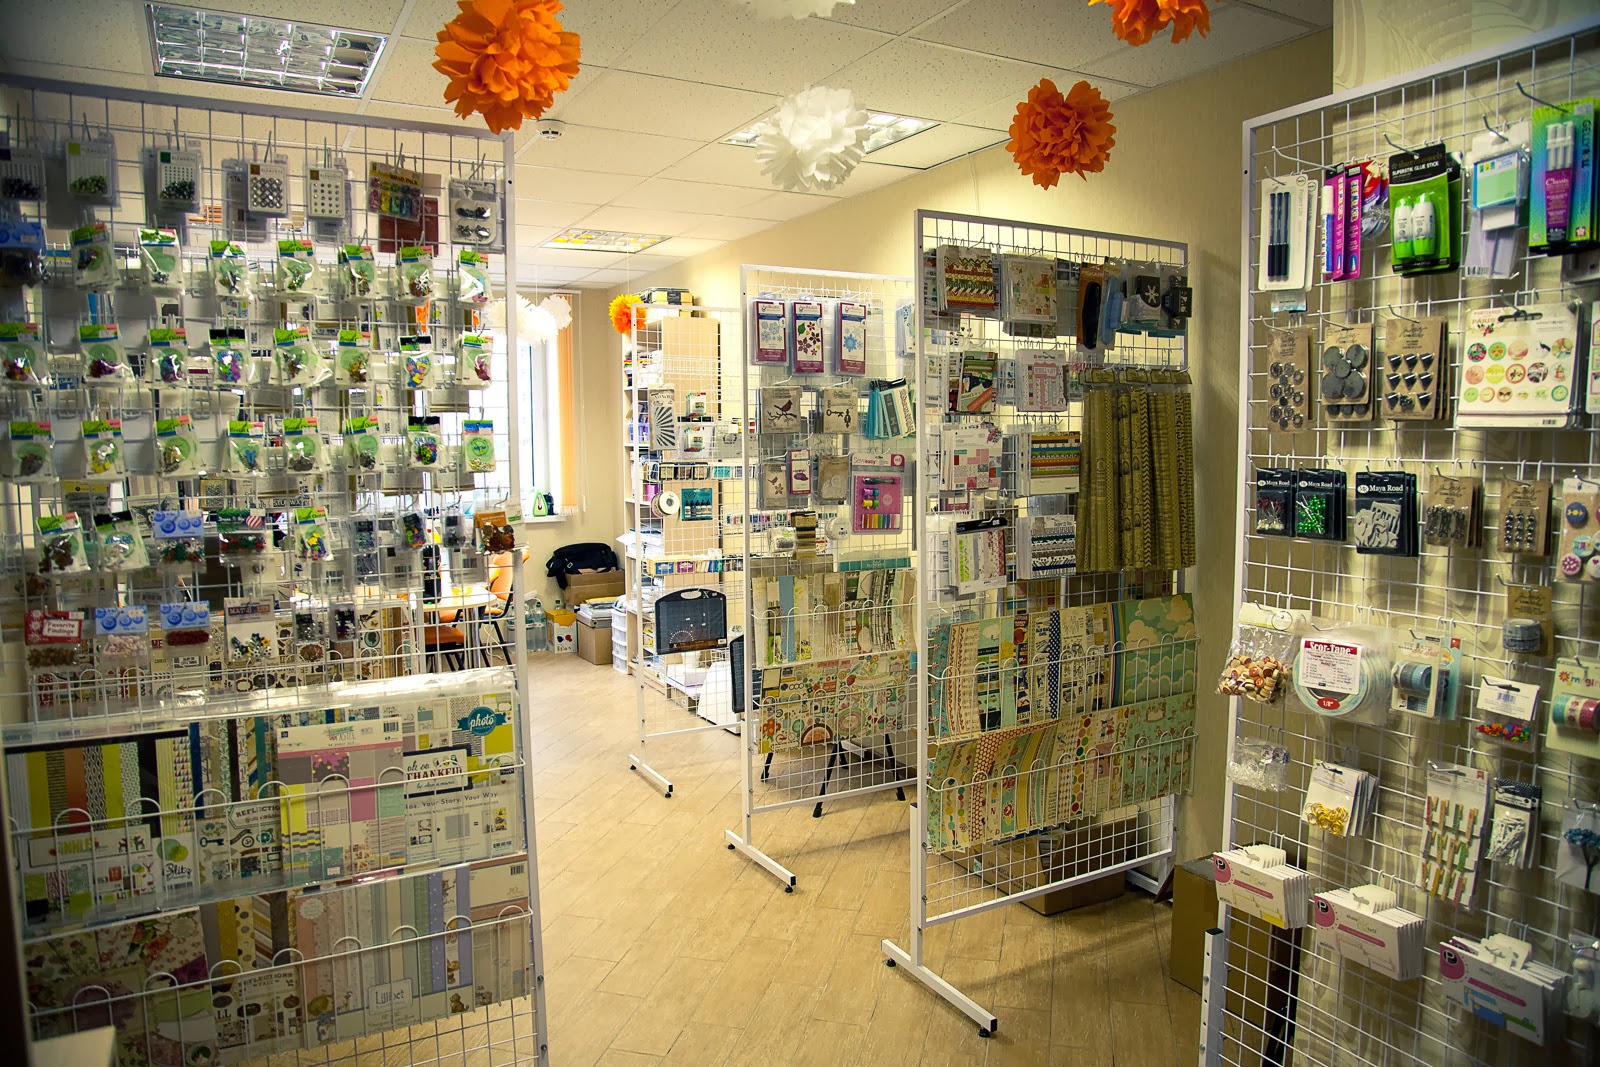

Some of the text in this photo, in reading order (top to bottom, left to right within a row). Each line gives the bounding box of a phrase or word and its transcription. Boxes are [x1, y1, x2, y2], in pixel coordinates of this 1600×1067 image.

[1426, 160, 1439, 168] STICK
[1369, 484, 1386, 492] Maya
[470, 713, 495, 732] photo
[464, 793, 480, 801] Your
